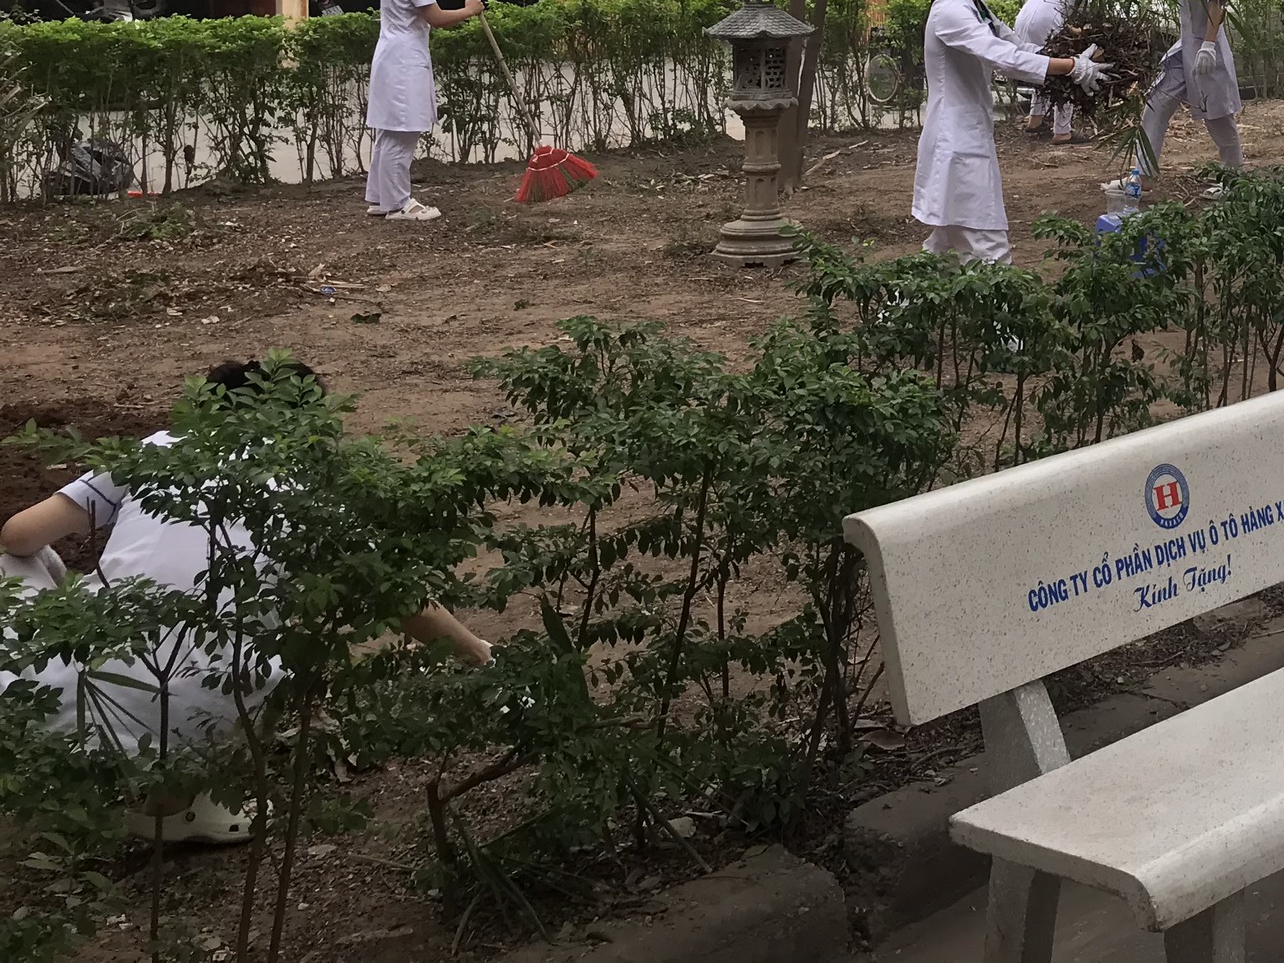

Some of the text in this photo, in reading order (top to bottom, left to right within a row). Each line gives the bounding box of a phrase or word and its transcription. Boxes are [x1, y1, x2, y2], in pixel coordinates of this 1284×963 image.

[1152, 481, 1184, 512] H
[1028, 580, 1069, 612] CÔNG
[1069, 570, 1088, 596] TY
[1092, 551, 1112, 588] CỔ
[1115, 542, 1153, 580] PHẦN
[1154, 537, 1187, 568] DỊCH
[1187, 529, 1206, 554] VỤ
[1208, 519, 1219, 545] Ô
[1220, 512, 1238, 540] TÔ
[1240, 504, 1274, 534] HÀNG
[1133, 554, 1232, 612] Kính Tặng!
